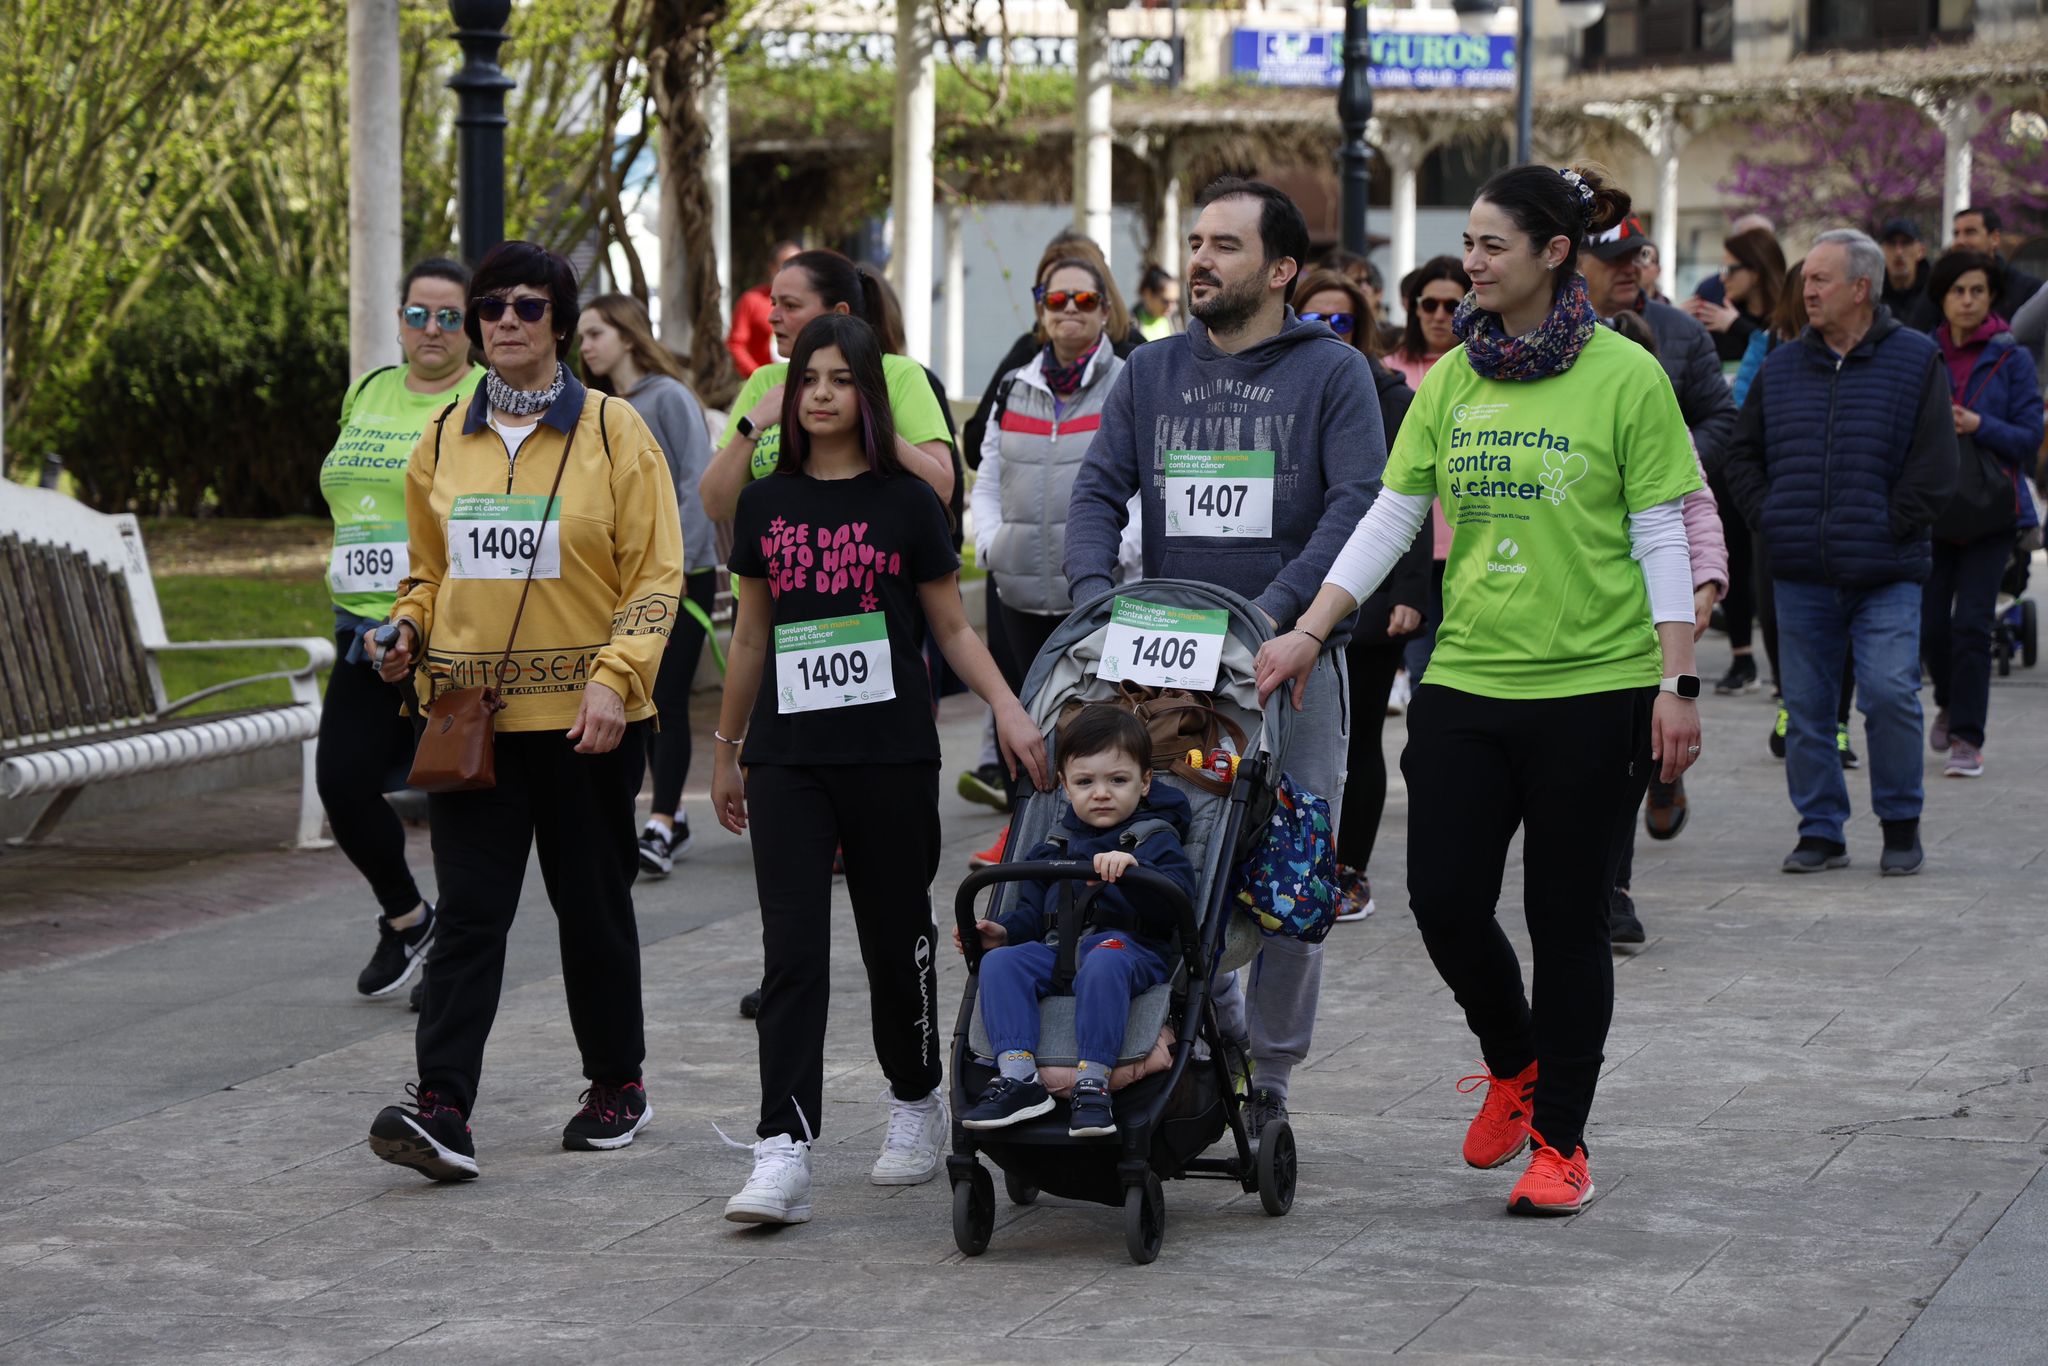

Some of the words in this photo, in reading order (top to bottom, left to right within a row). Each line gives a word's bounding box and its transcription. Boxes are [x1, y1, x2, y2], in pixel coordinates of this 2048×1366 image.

[1331, 34, 1490, 68] SGUROS
[1181, 378, 1274, 404] WILLIAMSBURG
[364, 429, 421, 441] march
[1451, 427, 1471, 448] En
[1476, 427, 1569, 453] marcha
[339, 453, 406, 469] cáncer
[753, 449, 767, 467] el
[1200, 461, 1225, 469] cáncer
[1448, 451, 1511, 474] contra
[1451, 477, 1462, 498] el
[1466, 475, 1545, 499] cáncer
[1185, 484, 1248, 517] 1407
[468, 527, 535, 559] 1408
[760, 523, 808, 558] NICE
[817, 522, 868, 549] DAY
[345, 548, 393, 576] 1369
[781, 544, 814, 568] TO
[1487, 561, 1527, 574] blendio
[1118, 608, 1143, 620] contra
[1144, 613, 1152, 621] el
[1153, 614, 1179, 625] cáncer
[1120, 600, 1165, 616] Torrelavega
[778, 624, 817, 636] Torrelavega
[778, 635, 798, 644] contra
[807, 630, 834, 639] cáncer
[1132, 636, 1198, 670] 1406
[450, 659, 521, 685] MITO
[530, 655, 588, 682] SEA
[797, 649, 868, 690] 1409
[512, 685, 569, 695] CATAMARAN
[914, 935, 932, 1066] Champion
